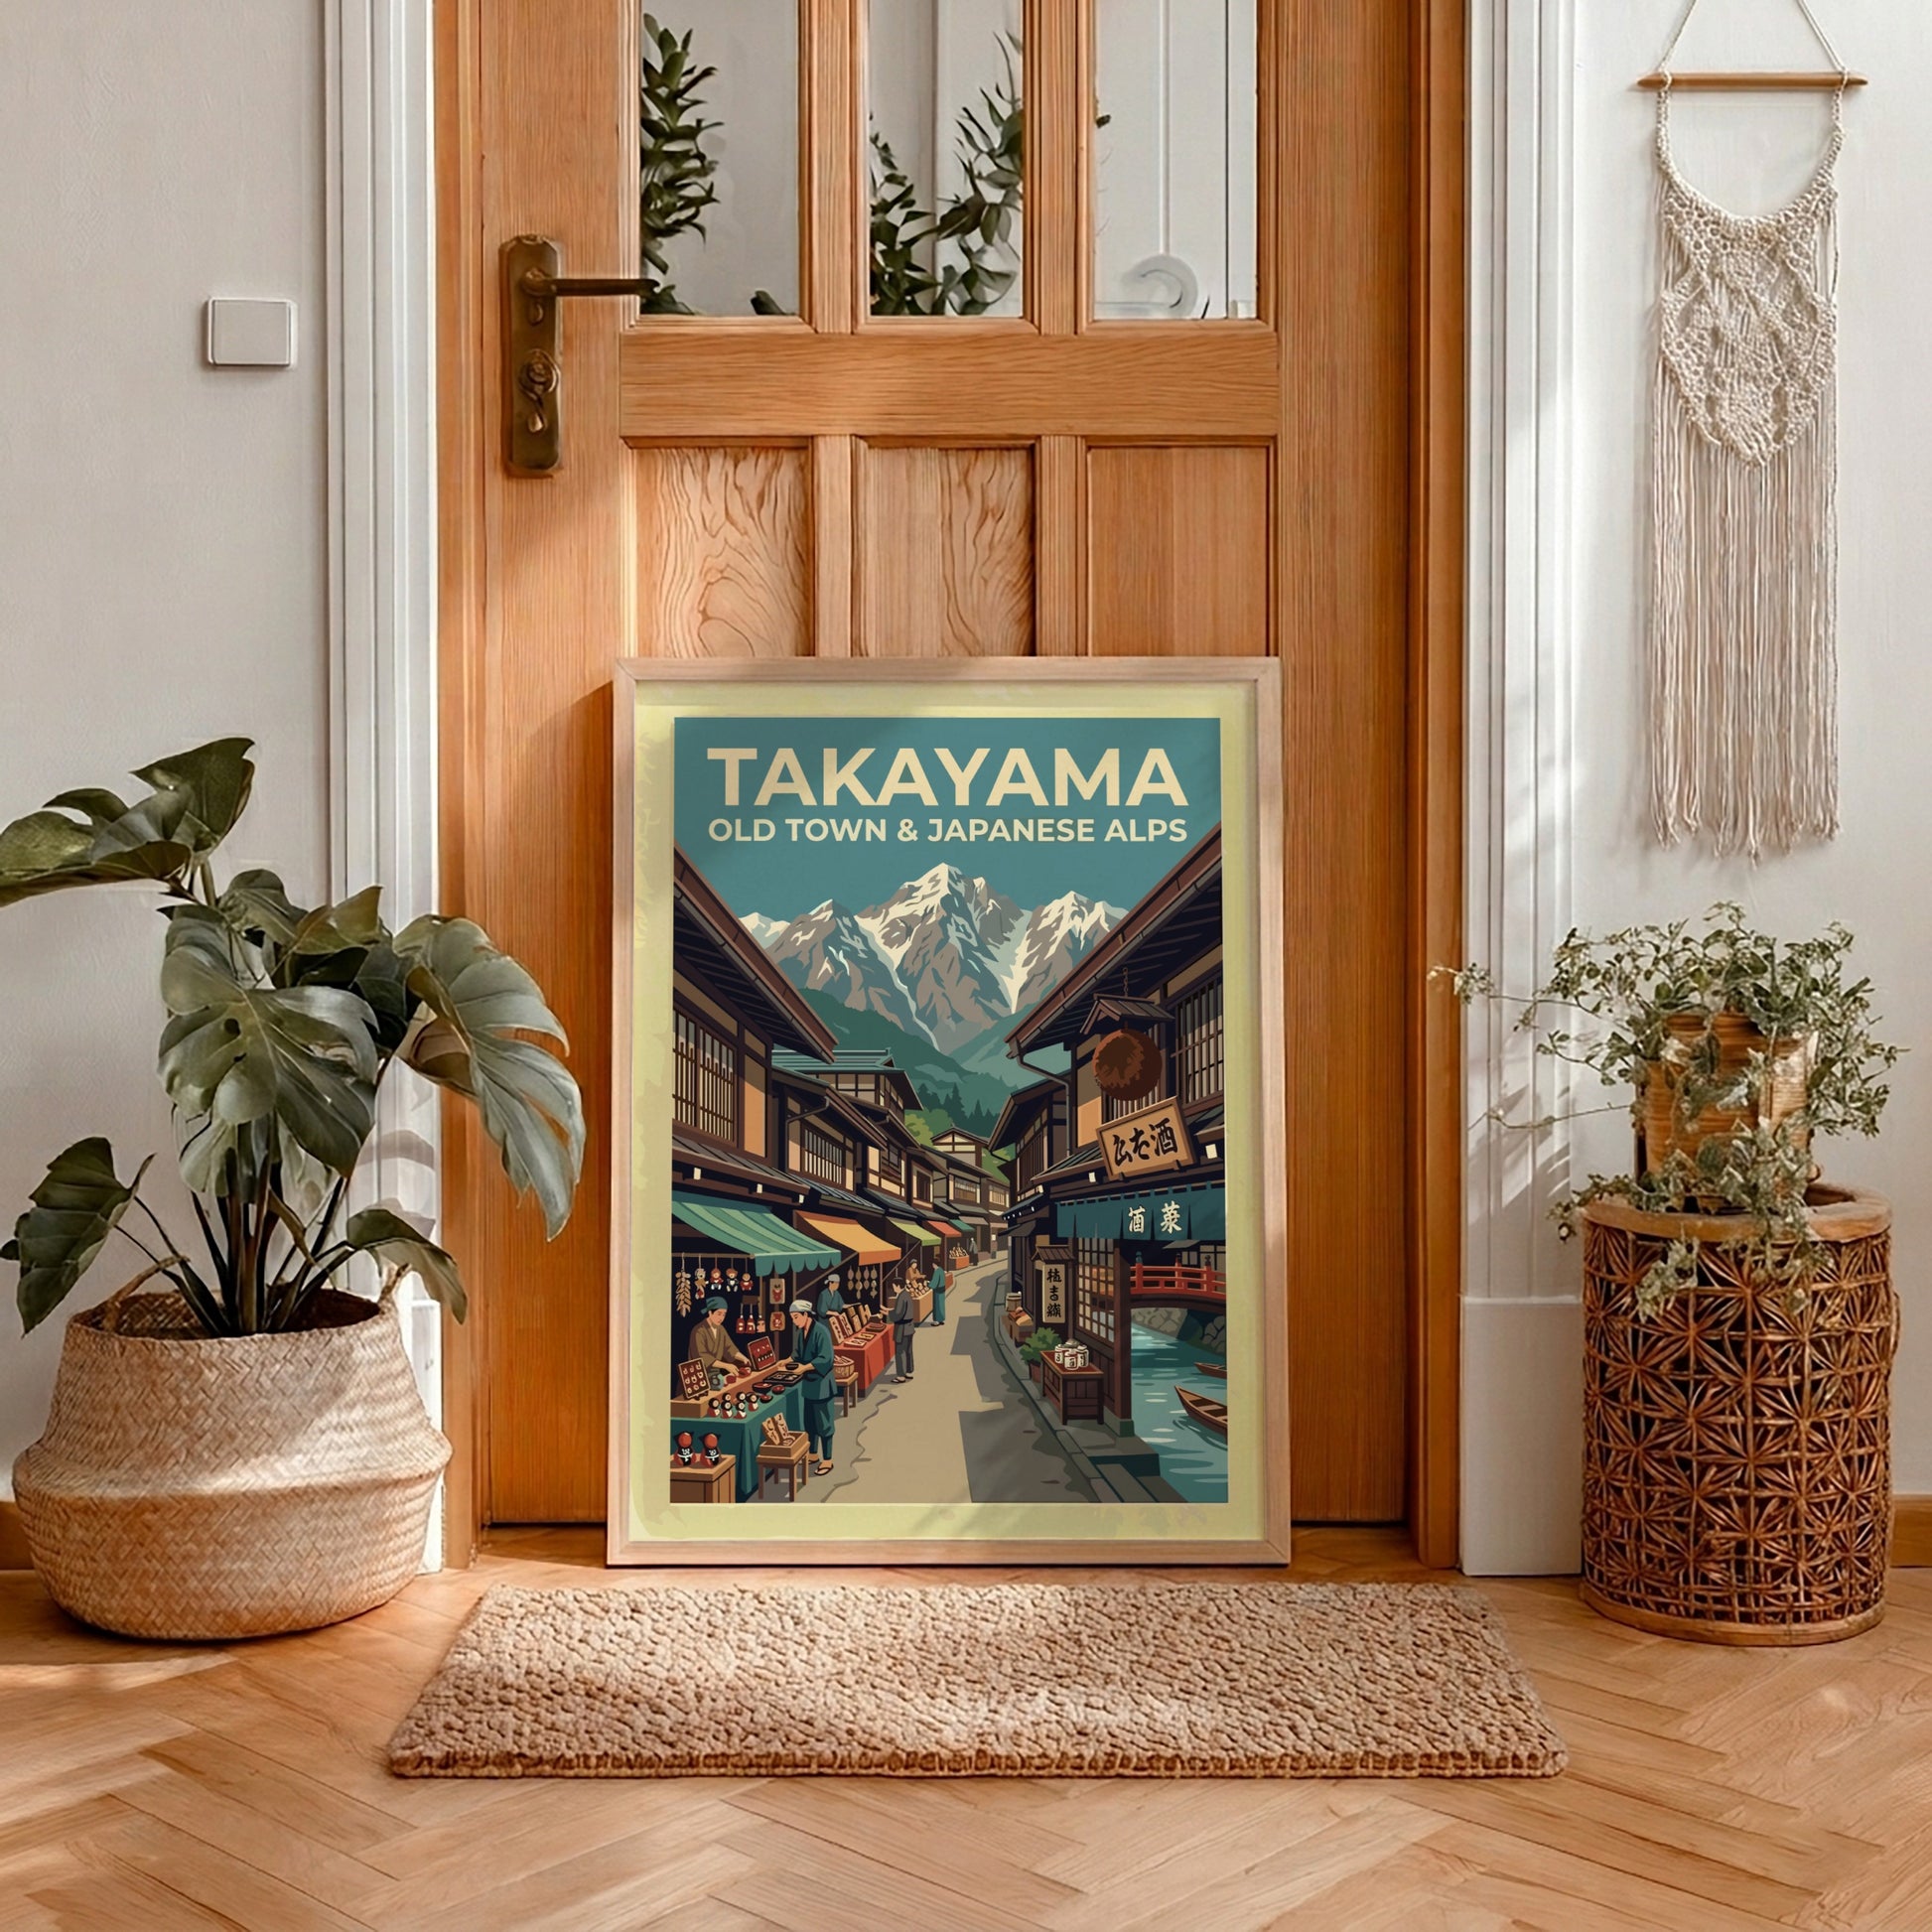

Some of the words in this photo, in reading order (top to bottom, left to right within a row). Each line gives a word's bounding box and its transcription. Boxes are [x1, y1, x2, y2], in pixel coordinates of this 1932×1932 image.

[707, 748, 1188, 806] TAKAYAMA
[709, 818, 775, 842] OLD
[785, 818, 886, 842] TOWN
[897, 818, 918, 842] &
[928, 818, 1094, 842] JAPANESE
[1105, 818, 1186, 842] ALPS
